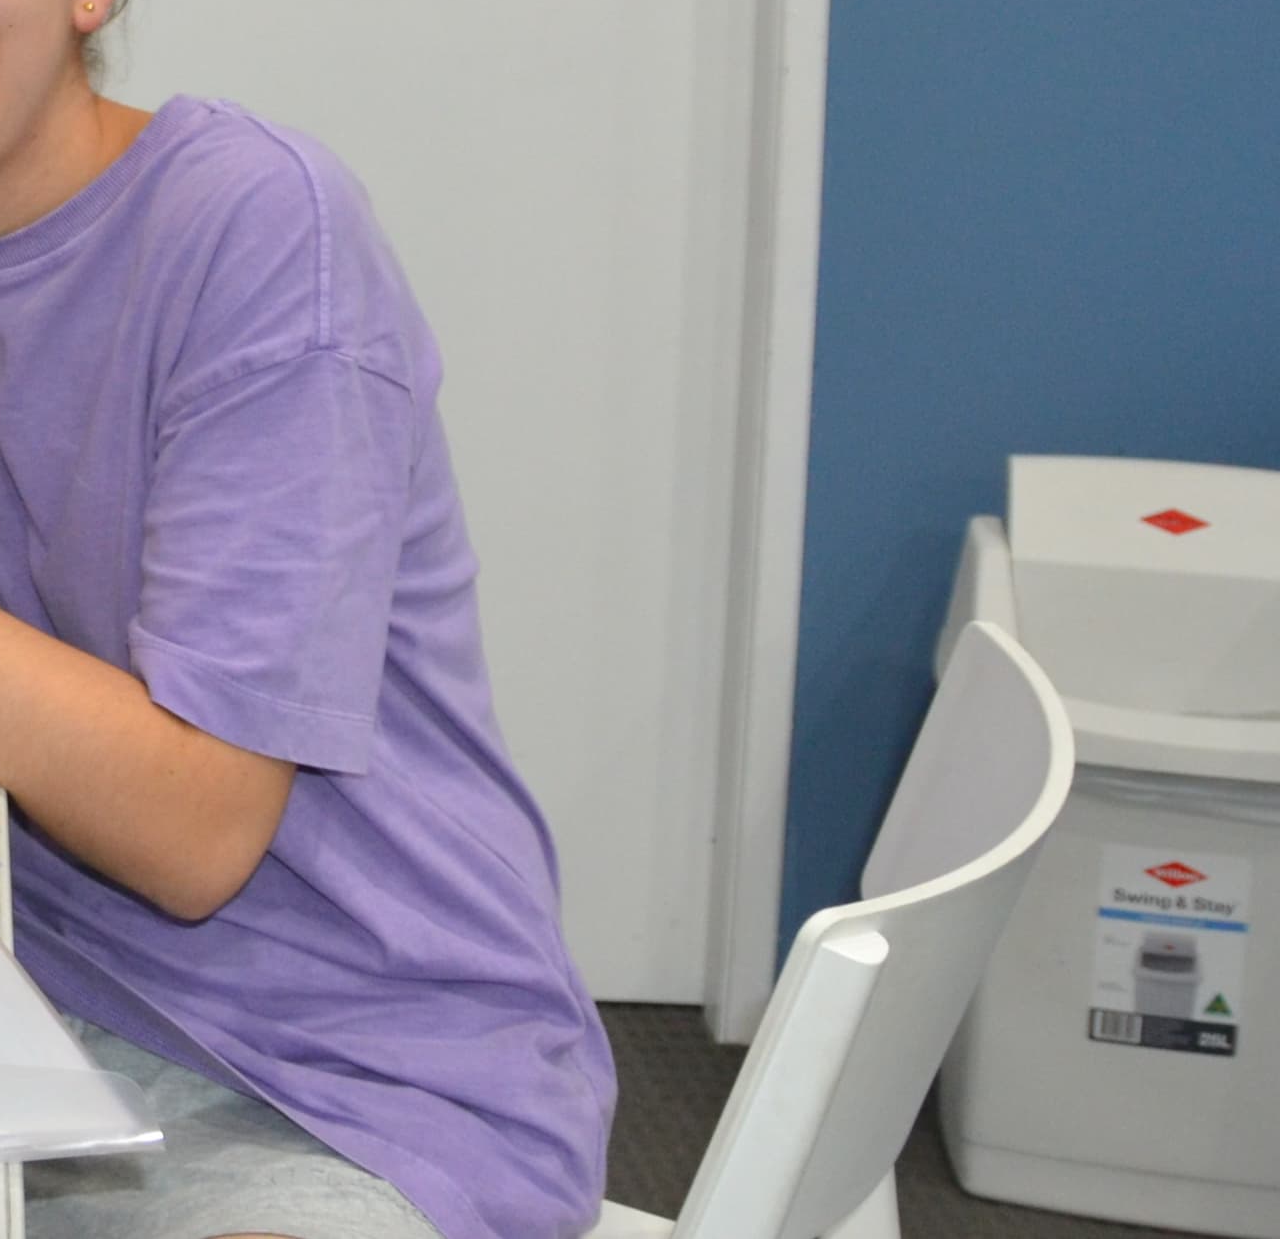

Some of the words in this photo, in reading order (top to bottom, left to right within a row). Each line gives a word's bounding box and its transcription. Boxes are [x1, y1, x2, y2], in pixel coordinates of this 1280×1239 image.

[1113, 888, 1171, 910] Swing
[1176, 895, 1187, 910] &
[1194, 897, 1233, 916] Stay
